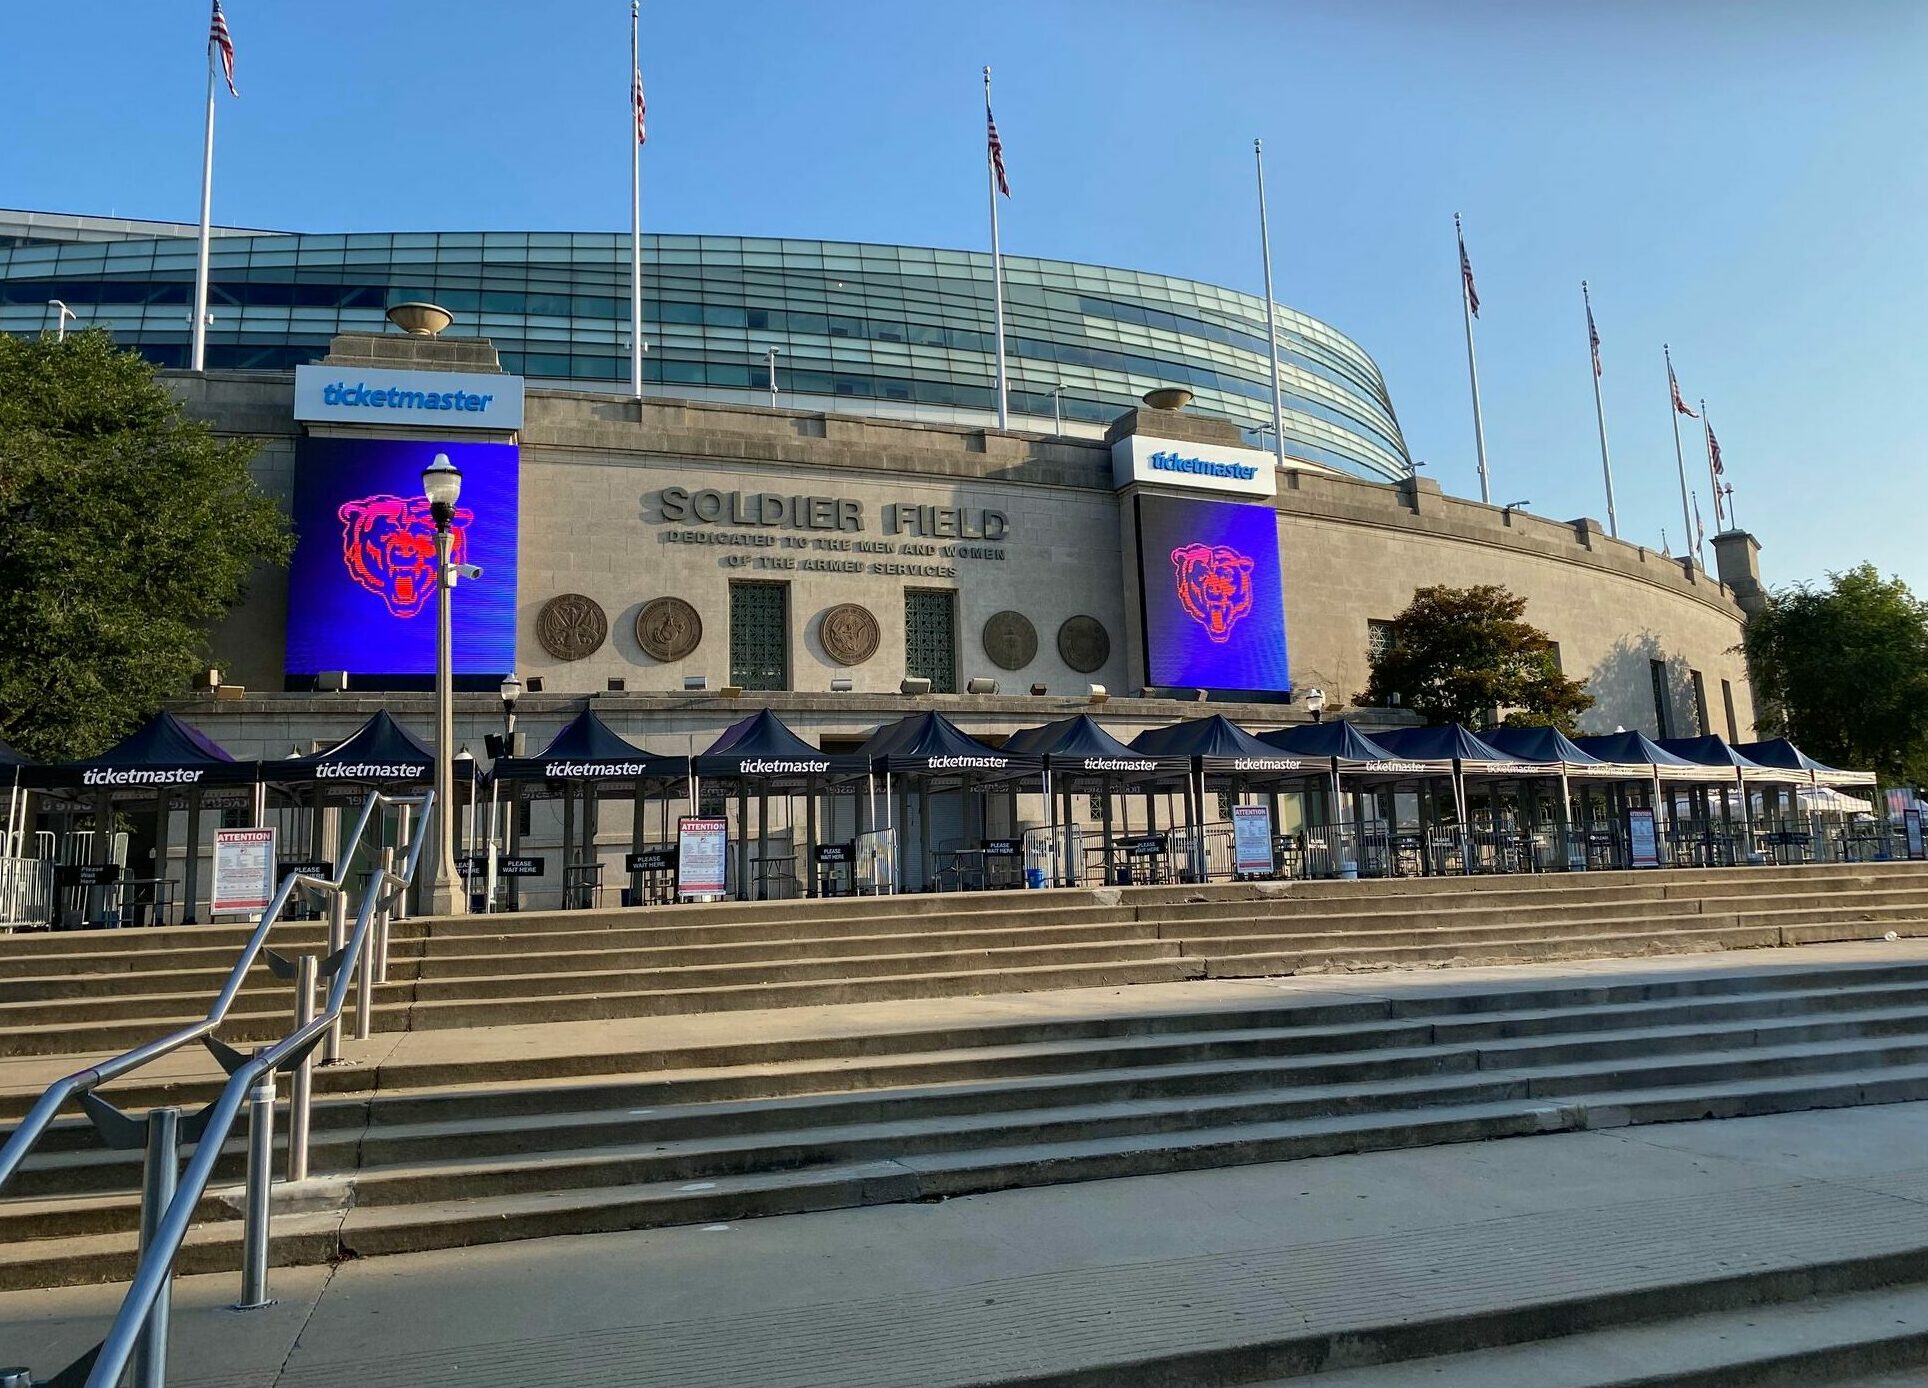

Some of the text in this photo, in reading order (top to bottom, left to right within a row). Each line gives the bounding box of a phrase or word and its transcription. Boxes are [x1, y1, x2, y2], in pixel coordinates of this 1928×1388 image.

[323, 382, 494, 412] ticketmaster
[1151, 451, 1258, 480] ticketmaster
[661, 486, 1010, 541] SOLDIER FIELD
[668, 530, 1006, 561] DEDICATED TO THE MEN AND WOMEN
[728, 555, 958, 578] OF THE ARMED SERVICES
[545, 762, 646, 776] ticketmaster
[739, 759, 830, 773] ticketmaster
[928, 755, 1008, 769] ticketmaster
[1084, 757, 1158, 771] ticketmaster
[1235, 758, 1301, 770] ticketmaster
[1366, 760, 1426, 772] ticketmaster
[1487, 763, 1540, 774] ticketmaster
[83, 768, 203, 785] ticketmaster
[316, 761, 425, 778] ticketmaster
[681, 823, 725, 831] ATTENTION
[217, 832, 270, 841] ATTENTION
